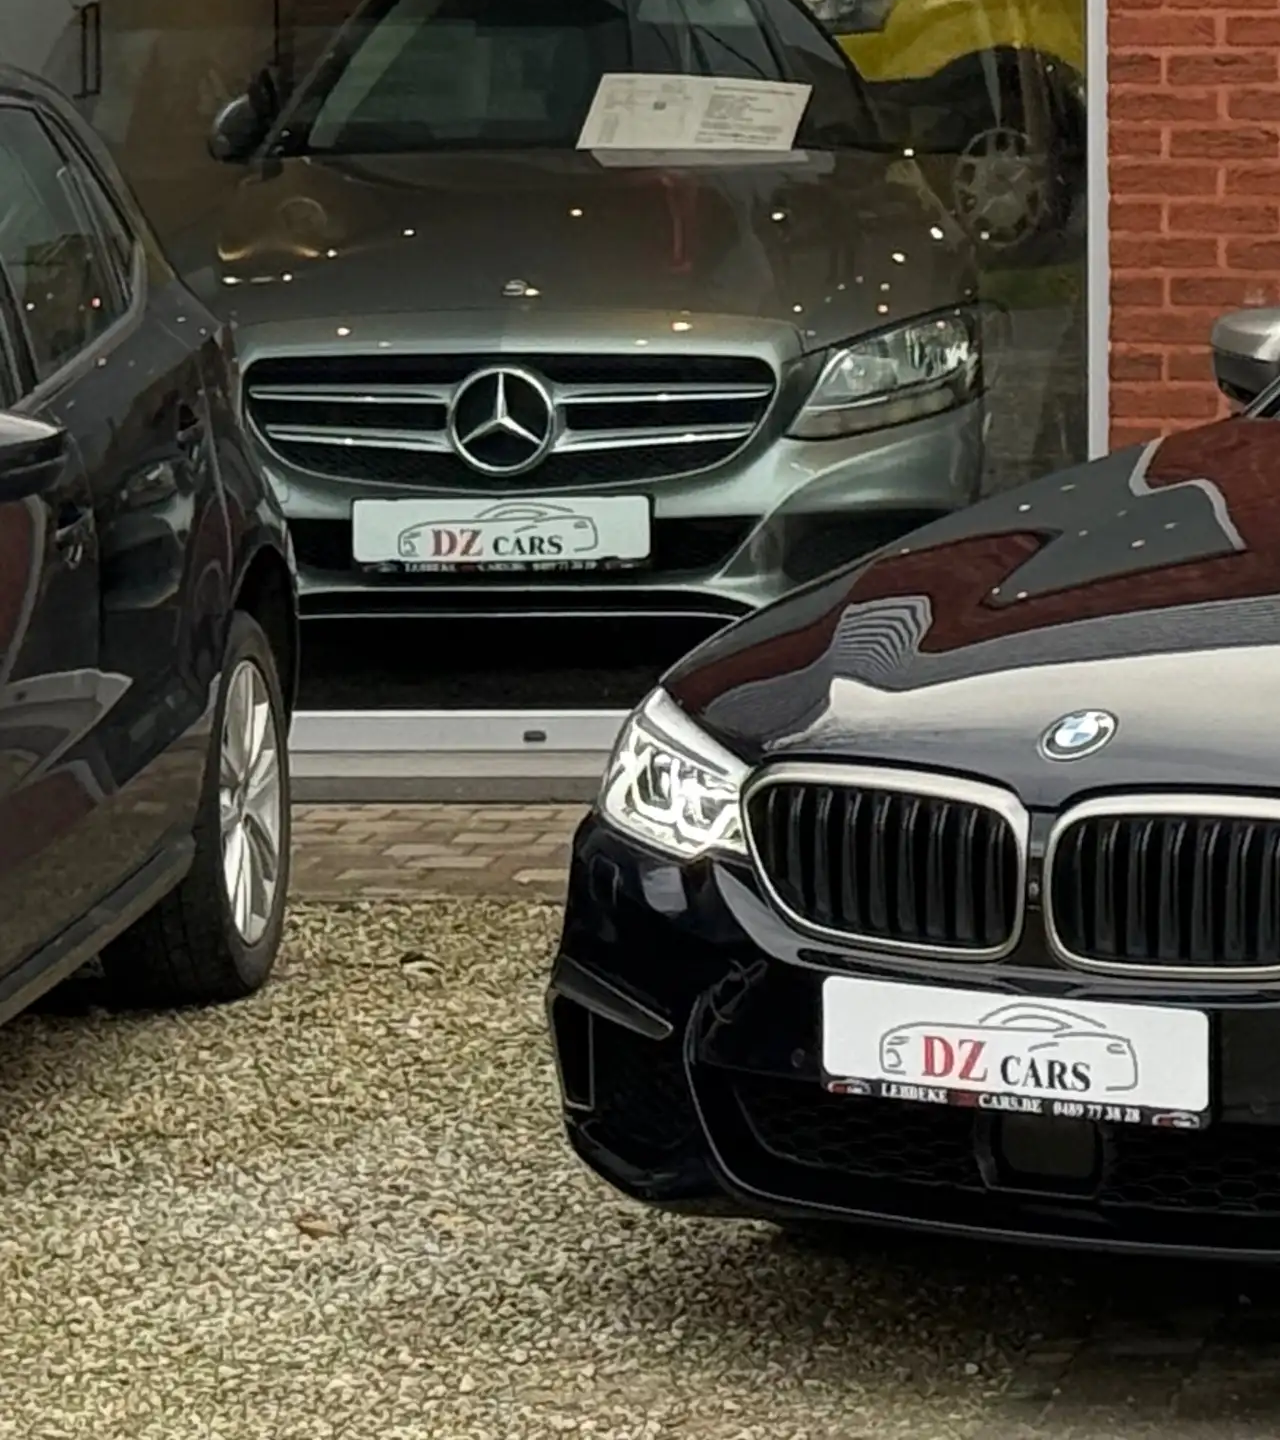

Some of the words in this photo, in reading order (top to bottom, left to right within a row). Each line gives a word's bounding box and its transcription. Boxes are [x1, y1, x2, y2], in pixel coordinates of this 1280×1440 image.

[431, 528, 483, 557] DZ
[492, 535, 563, 556] CARS
[922, 1035, 988, 1083] DZ
[1000, 1054, 1092, 1093] CARS
